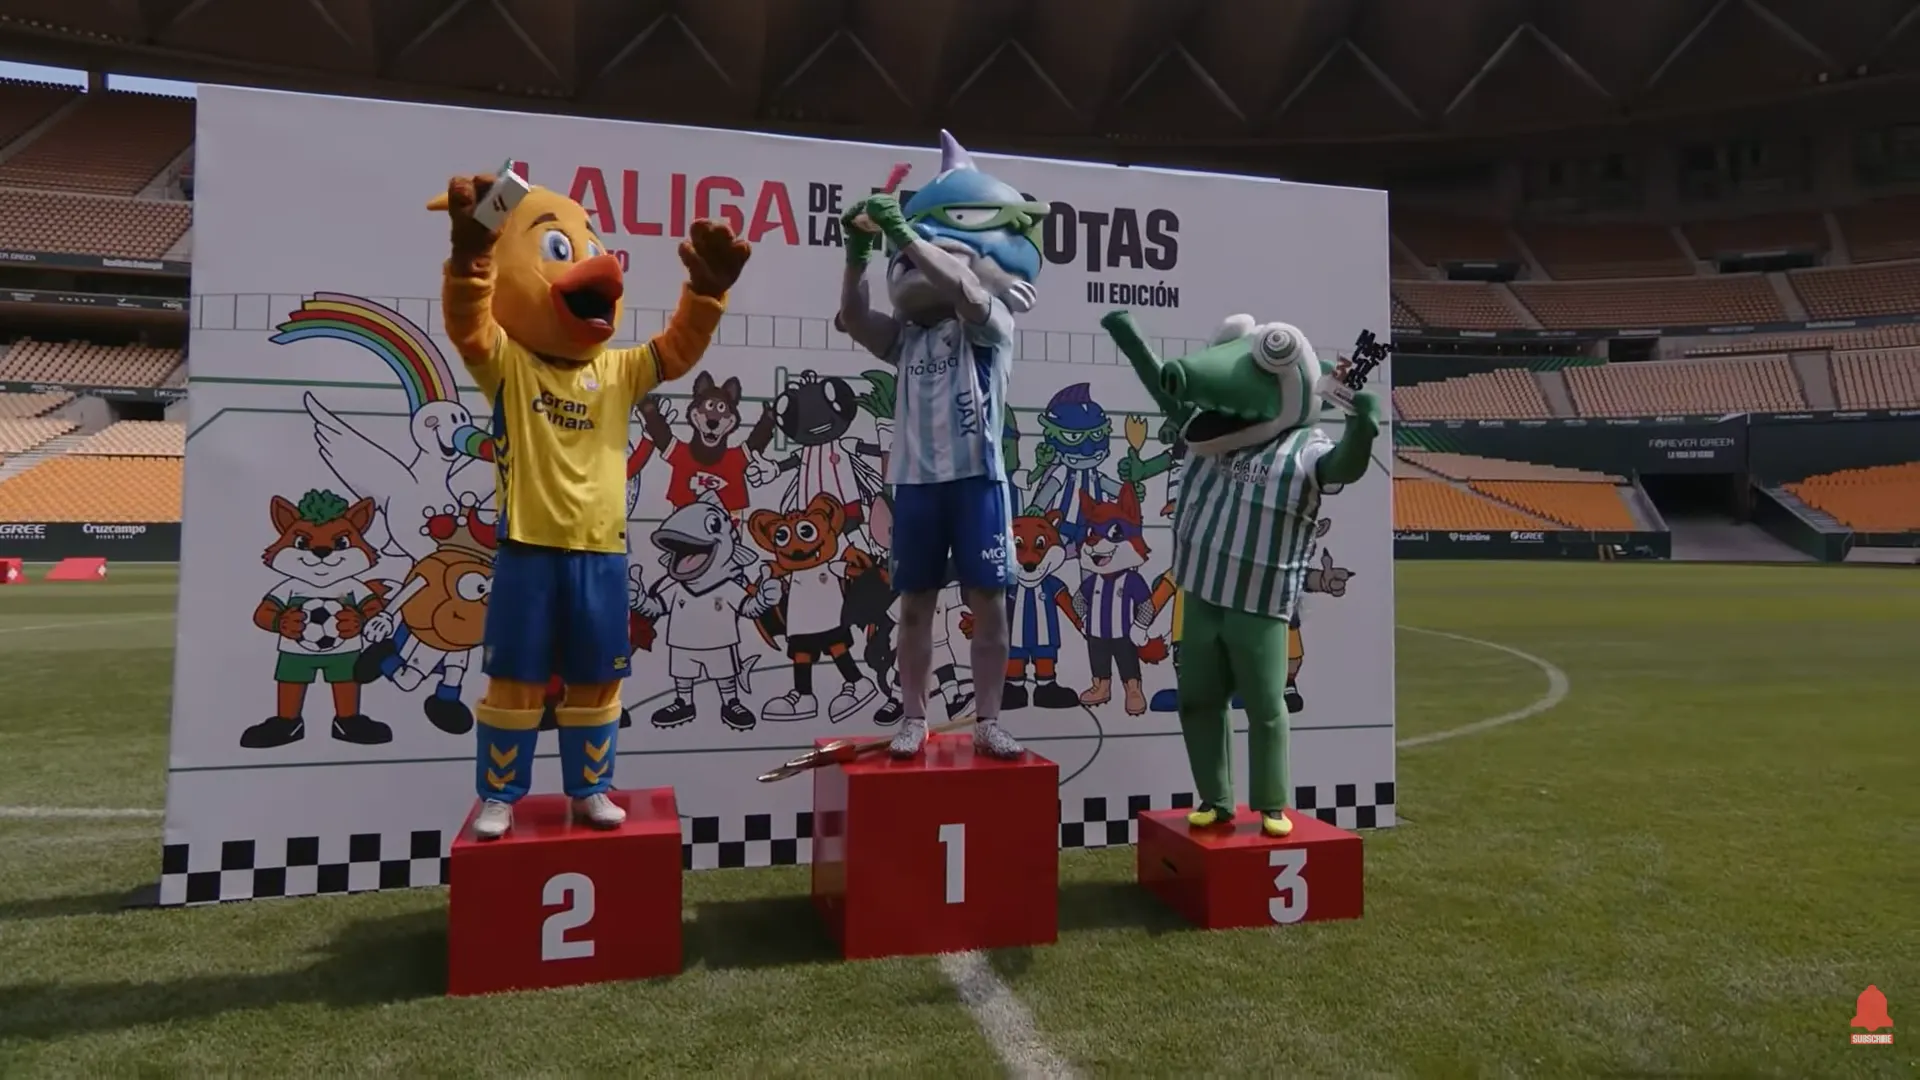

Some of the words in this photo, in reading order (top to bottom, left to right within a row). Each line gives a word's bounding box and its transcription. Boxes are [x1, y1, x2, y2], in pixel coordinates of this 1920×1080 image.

[809, 182, 843, 215] DE
[808, 216, 848, 249] LA
[1087, 281, 1105, 304] III
[1109, 280, 1179, 308] EDICIÓN
[541, 390, 587, 416] Gran
[0, 524, 46, 534] GREE
[83, 523, 147, 535] Cruzcampo
[1519, 532, 1545, 541] GREE
[938, 823, 966, 905] 1
[1267, 848, 1310, 925] 3
[541, 872, 596, 961] 2
